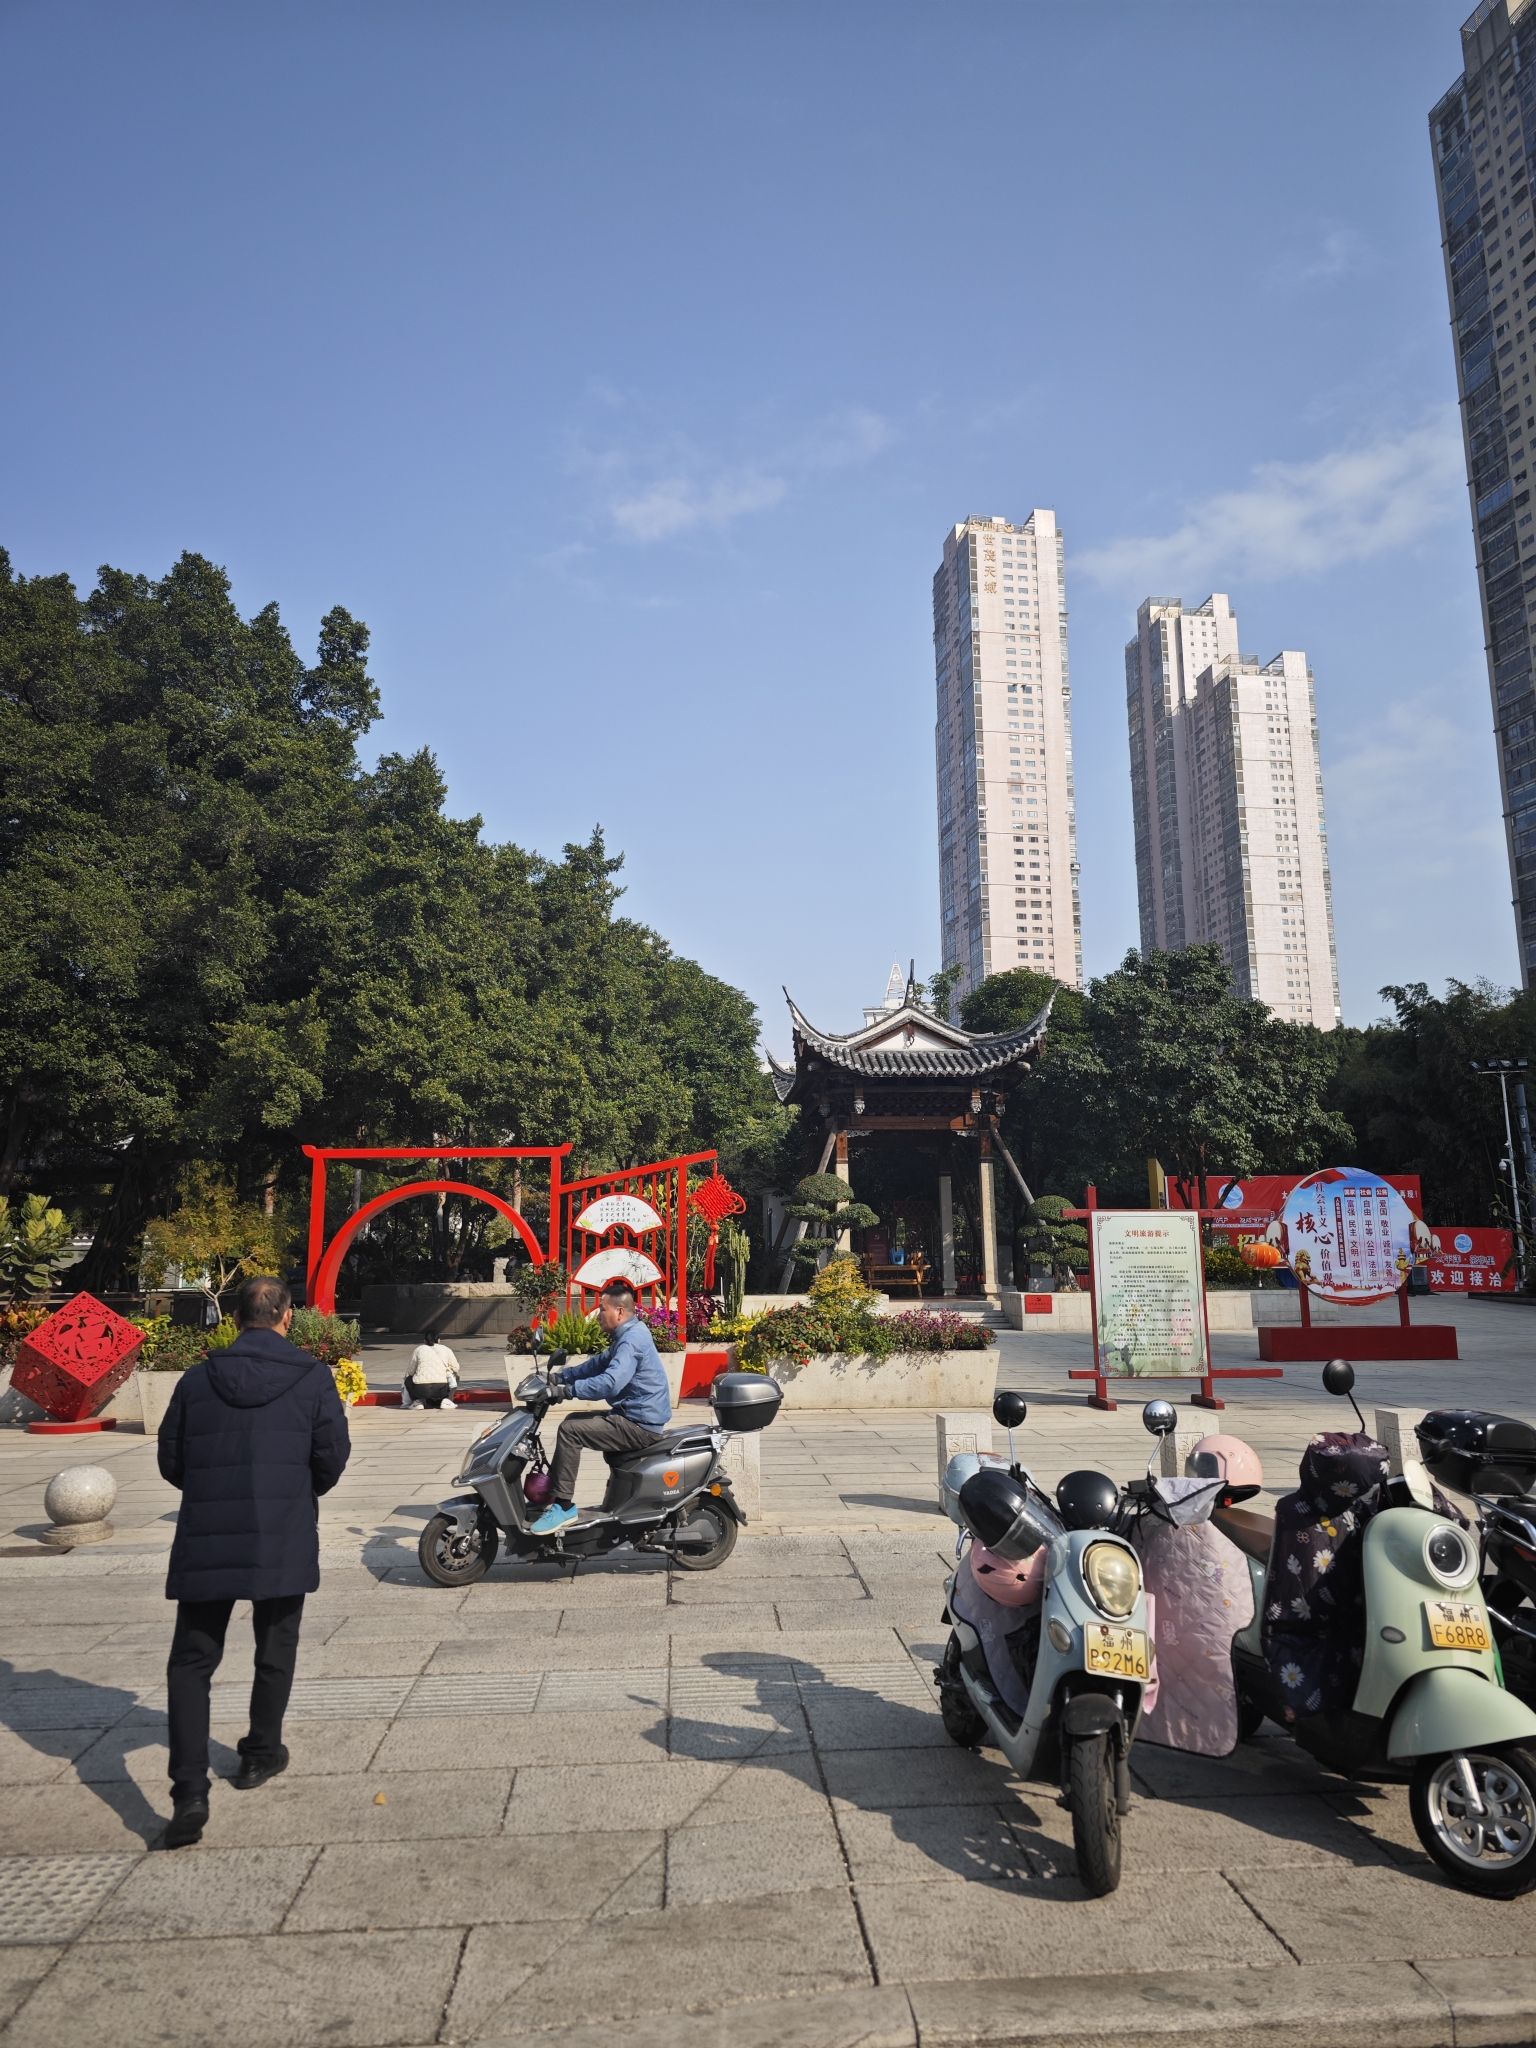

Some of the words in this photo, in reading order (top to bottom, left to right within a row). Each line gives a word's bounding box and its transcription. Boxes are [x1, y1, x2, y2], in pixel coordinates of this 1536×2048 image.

[983, 534, 998, 594] 世茂天城
[1314, 1182, 1328, 1228] 社会主义
[1346, 1200, 1356, 1216] 富强
[1363, 1200, 1371, 1216] 自由
[1379, 1199, 1387, 1216] 爱国
[1124, 1229, 1170, 1238] 文明旅游提示
[1296, 1211, 1334, 1245] 核心
[1348, 1220, 1357, 1236] 民主
[1364, 1220, 1373, 1236] 平等
[1380, 1219, 1389, 1236] 敬业
[1350, 1240, 1359, 1257] 文明
[1366, 1240, 1375, 1257] 公正
[1382, 1240, 1391, 1257] 诚信
[1320, 1248, 1333, 1283] 价值观
[1352, 1260, 1361, 1277] 和谐
[1368, 1260, 1377, 1277] 法治
[1384, 1260, 1393, 1277] 友善
[1430, 1269, 1502, 1288] 欢迎接洽
[1441, 1604, 1472, 1623] 福州
[1101, 1633, 1133, 1651] 福州
[1433, 1624, 1486, 1646] F68R8
